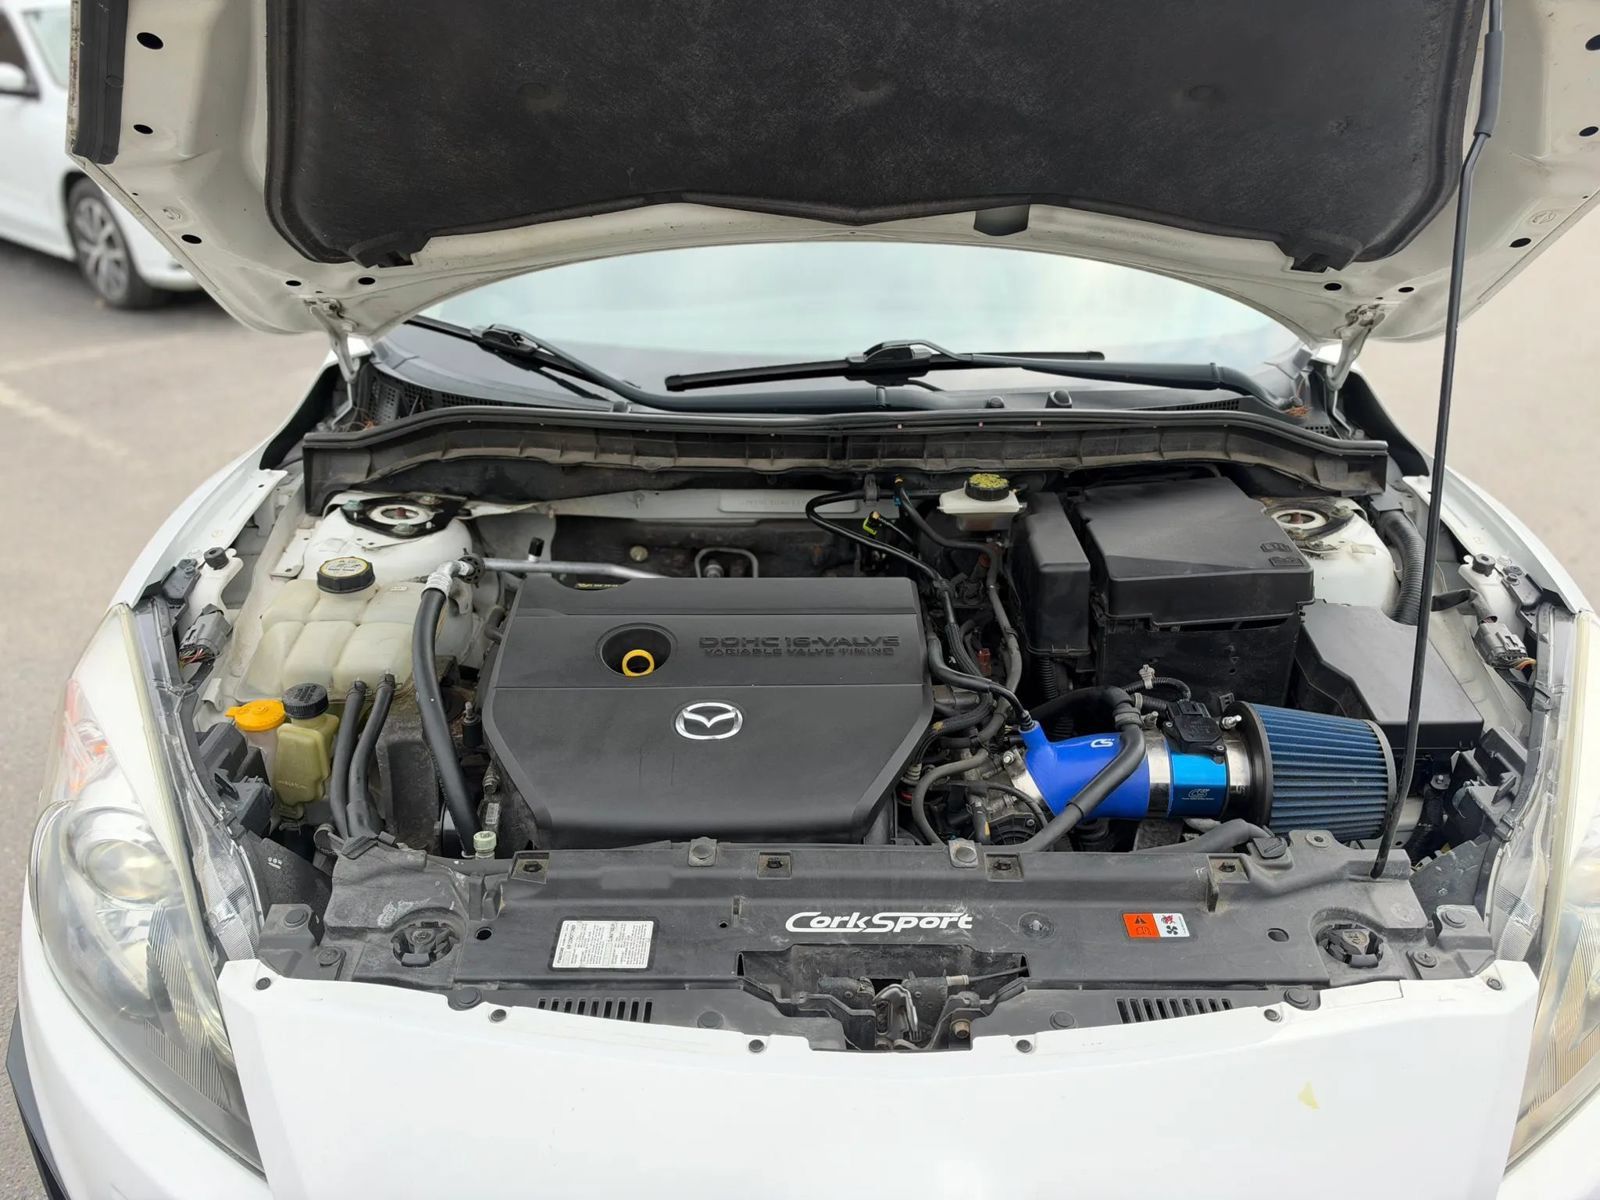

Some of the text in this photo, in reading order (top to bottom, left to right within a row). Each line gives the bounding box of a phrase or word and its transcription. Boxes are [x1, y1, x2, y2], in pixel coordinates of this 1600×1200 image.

[698, 635, 900, 649] DOHC 16-VALVE
[704, 648, 782, 657] VARIABLE
[787, 648, 835, 657] VALVE
[785, 911, 973, 932] CorkSport
